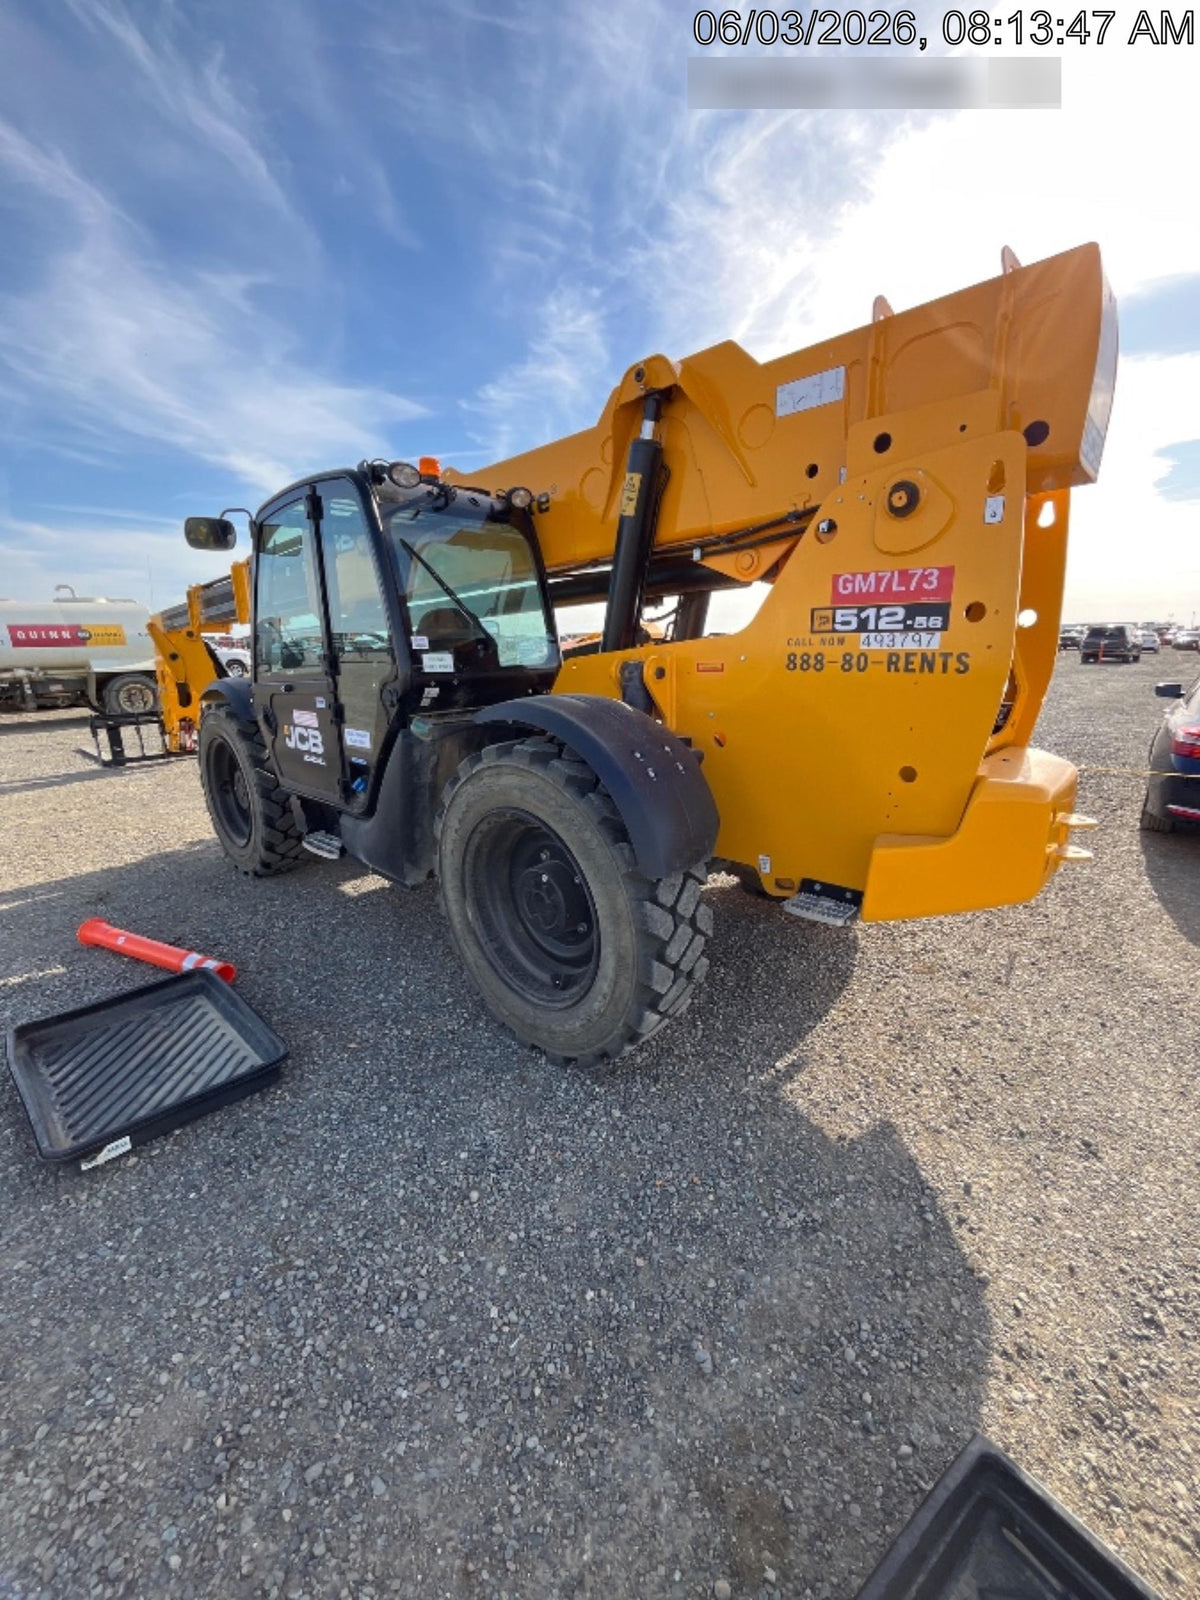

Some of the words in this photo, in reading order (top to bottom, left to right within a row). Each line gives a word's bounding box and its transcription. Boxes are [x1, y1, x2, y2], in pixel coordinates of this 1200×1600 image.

[838, 568, 940, 594] GM7L73
[16, 631, 71, 639] QUINN
[787, 637, 814, 647] CALL
[820, 636, 846, 648] NOW
[862, 633, 936, 648] 493797
[786, 652, 970, 674] 888-80-RENTS
[286, 725, 324, 754] JCB
